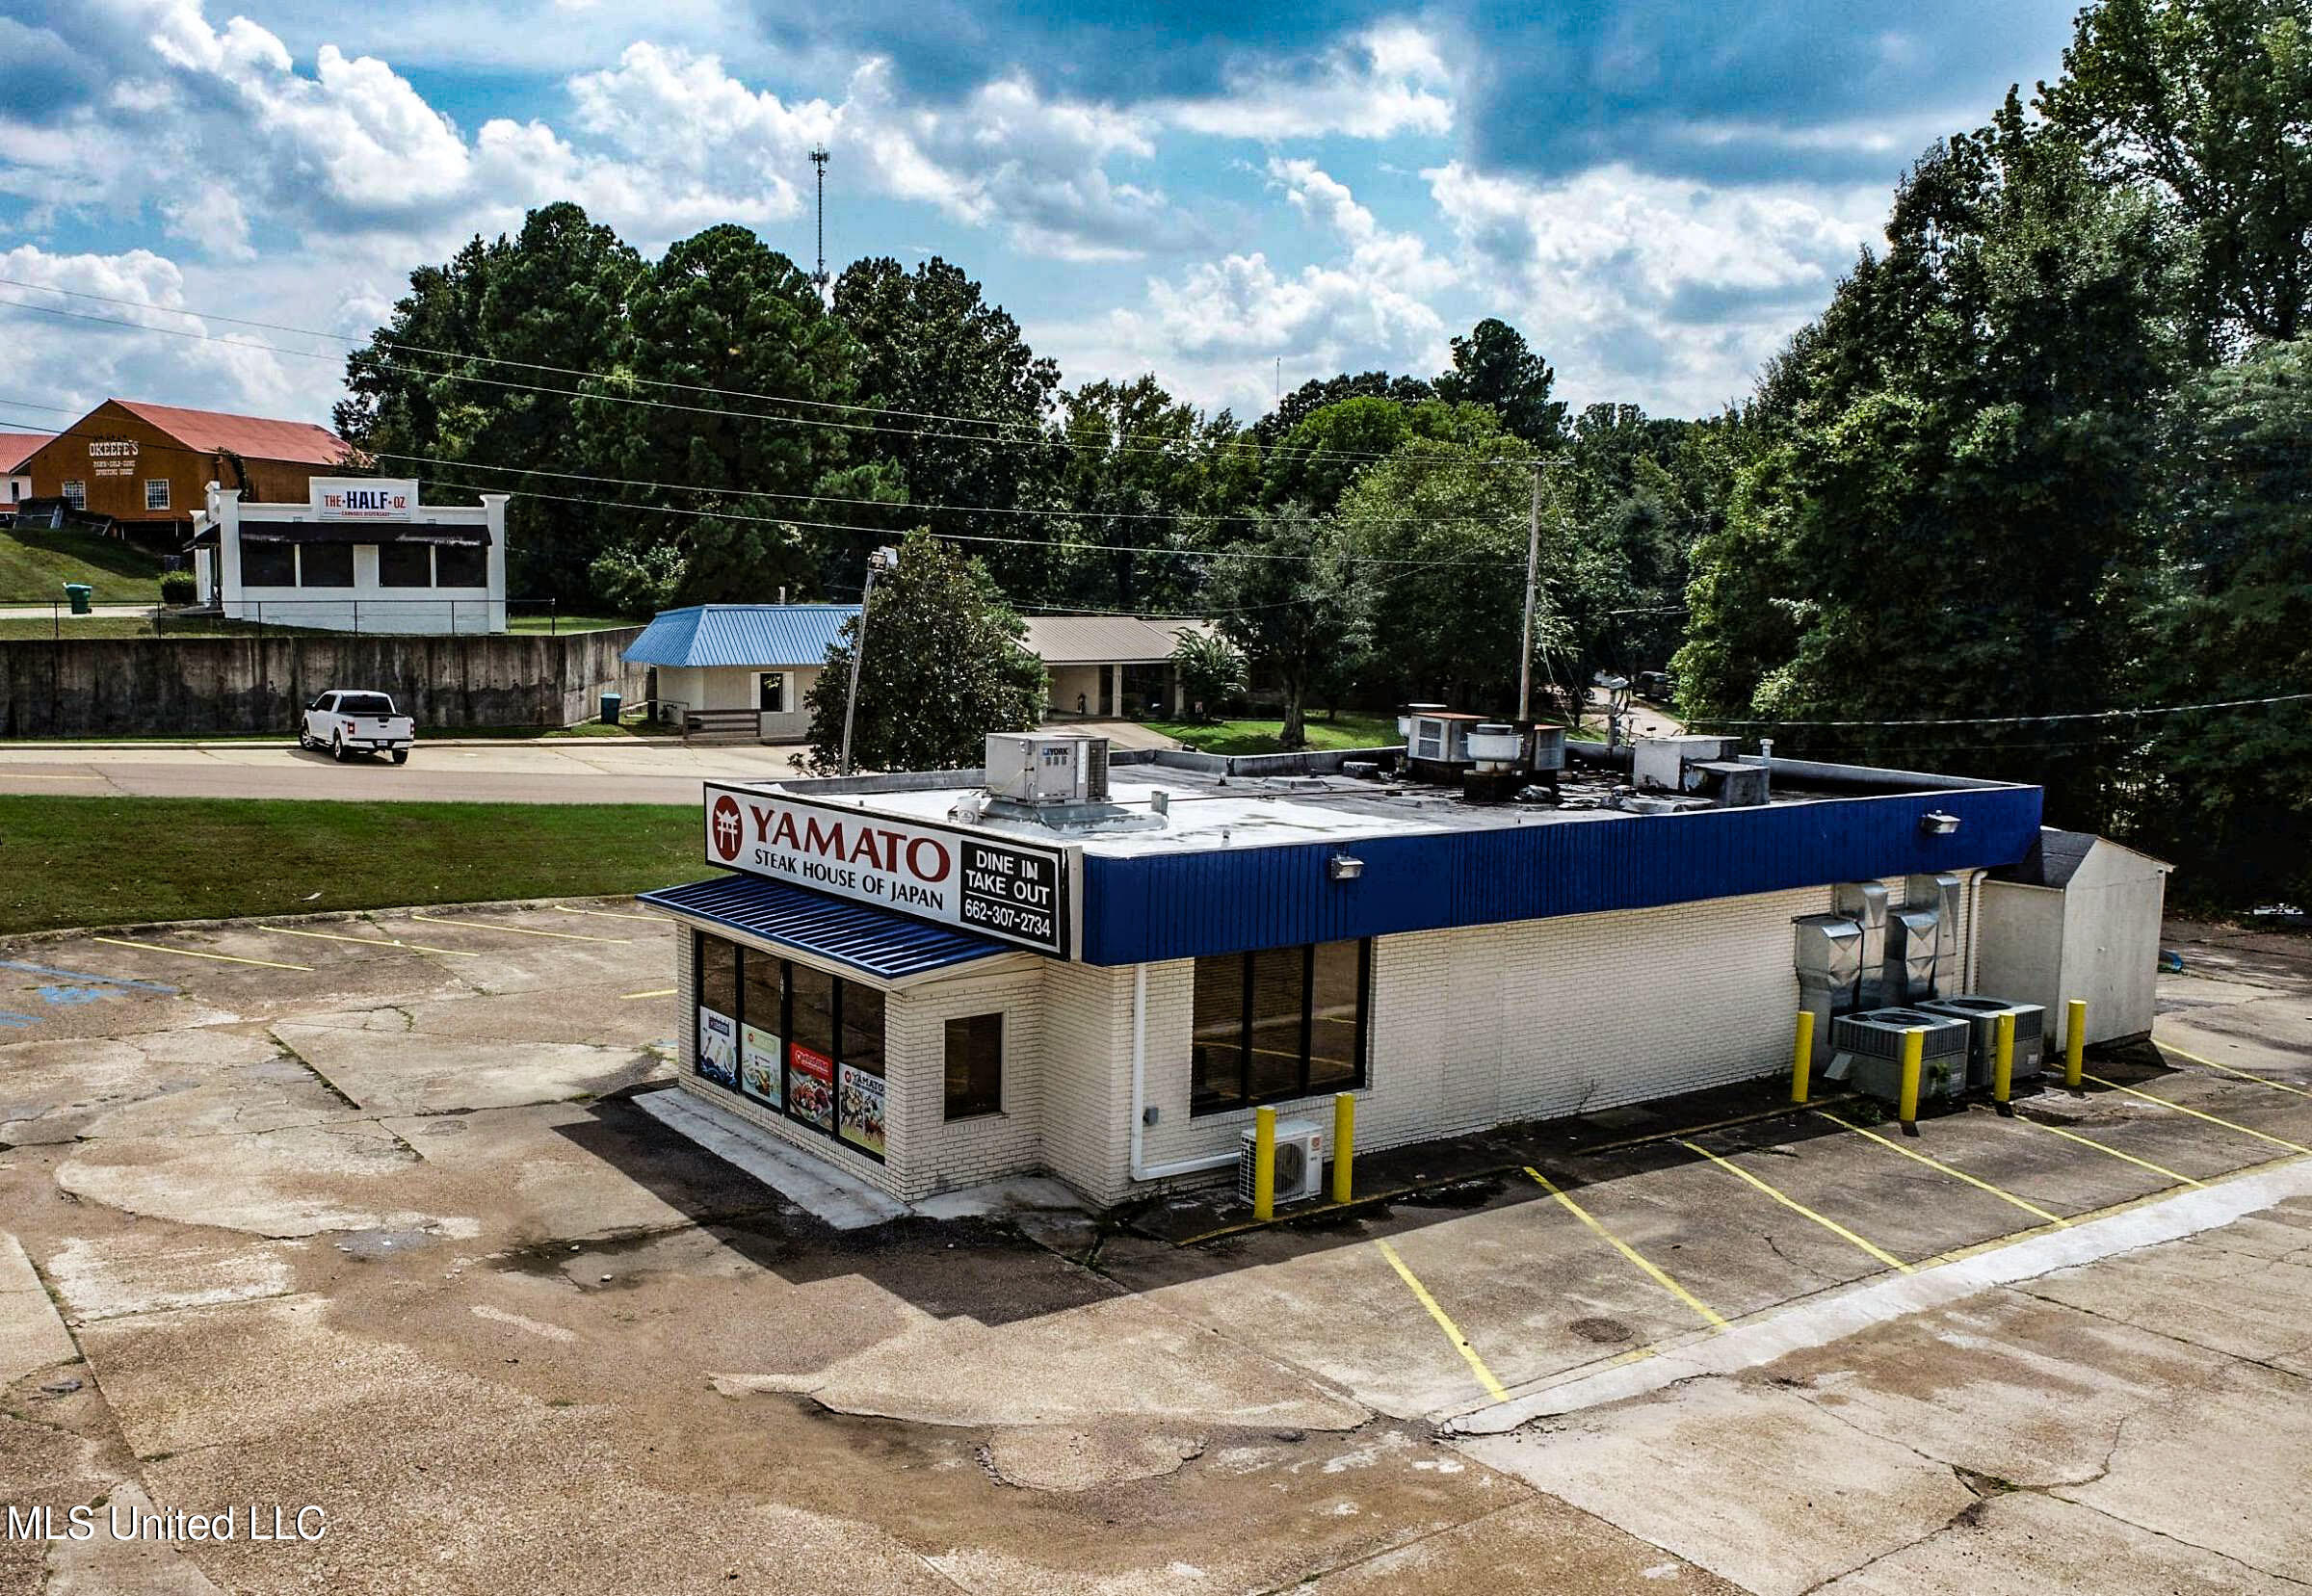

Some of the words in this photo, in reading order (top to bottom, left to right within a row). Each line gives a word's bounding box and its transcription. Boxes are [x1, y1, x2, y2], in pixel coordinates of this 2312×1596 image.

[324, 494, 342, 508] THE
[347, 491, 388, 510] HALF
[393, 496, 407, 509] OZ
[1049, 747, 1068, 756] YORK
[749, 803, 951, 883] YAMATO
[755, 849, 798, 875] STEAK
[803, 861, 856, 888] HOUSE
[862, 875, 885, 896] OF
[890, 881, 943, 911] JAPAN
[976, 850, 1014, 876] DINE
[1021, 859, 1038, 880] IN
[965, 869, 1007, 896] TAKE
[1013, 880, 1050, 905] OUT
[965, 899, 1051, 937] 662-307-2734
[852, 1071, 884, 1092] YAMATO
